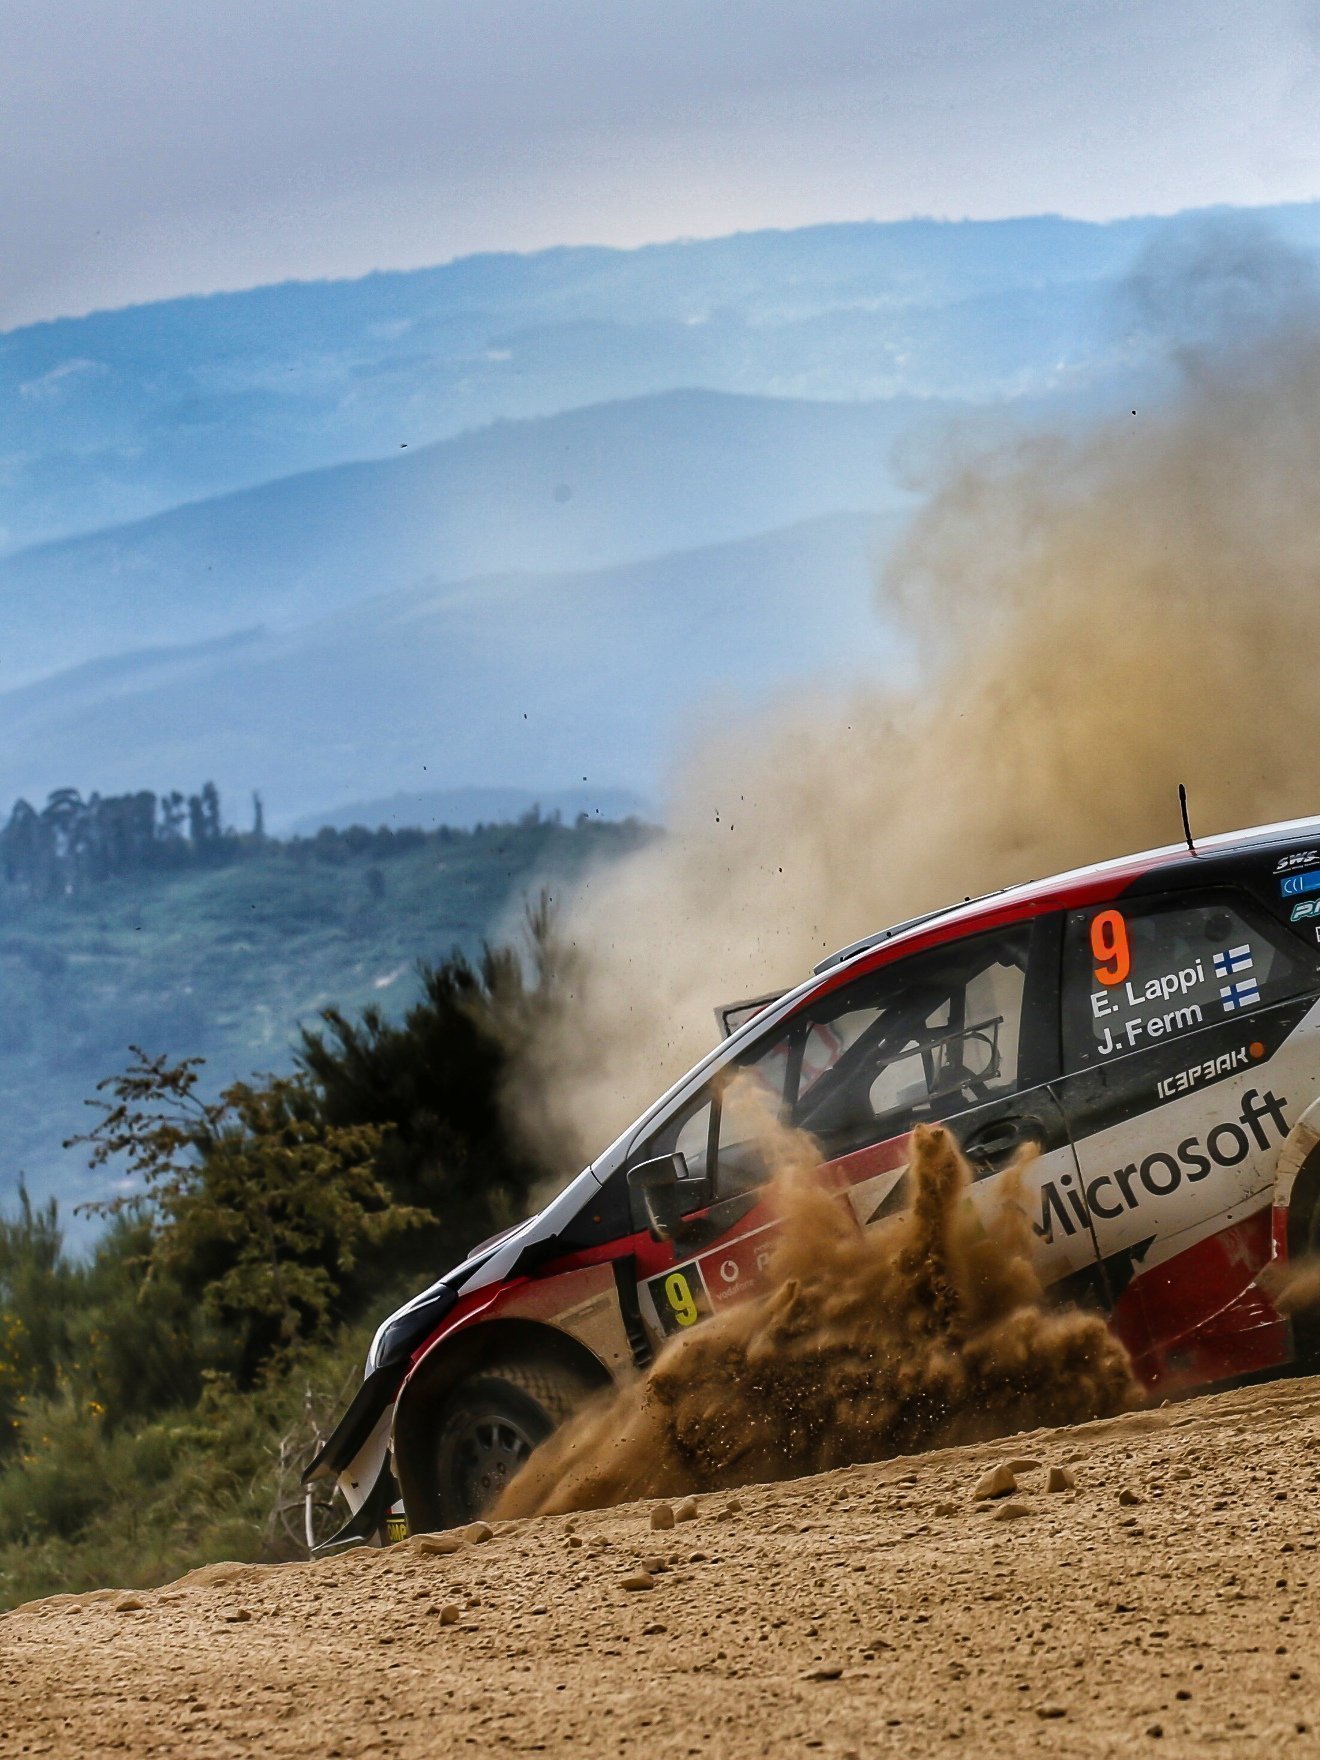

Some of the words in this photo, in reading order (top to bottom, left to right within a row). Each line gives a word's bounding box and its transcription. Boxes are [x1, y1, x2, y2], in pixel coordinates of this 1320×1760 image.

[1091, 909, 1130, 986] 9
[1091, 991, 1119, 1018] E.
[1126, 960, 1205, 1007] Lappi
[1097, 1029, 1121, 1055] J.
[1125, 1003, 1203, 1046] Ferm
[665, 1273, 698, 1327] 9
